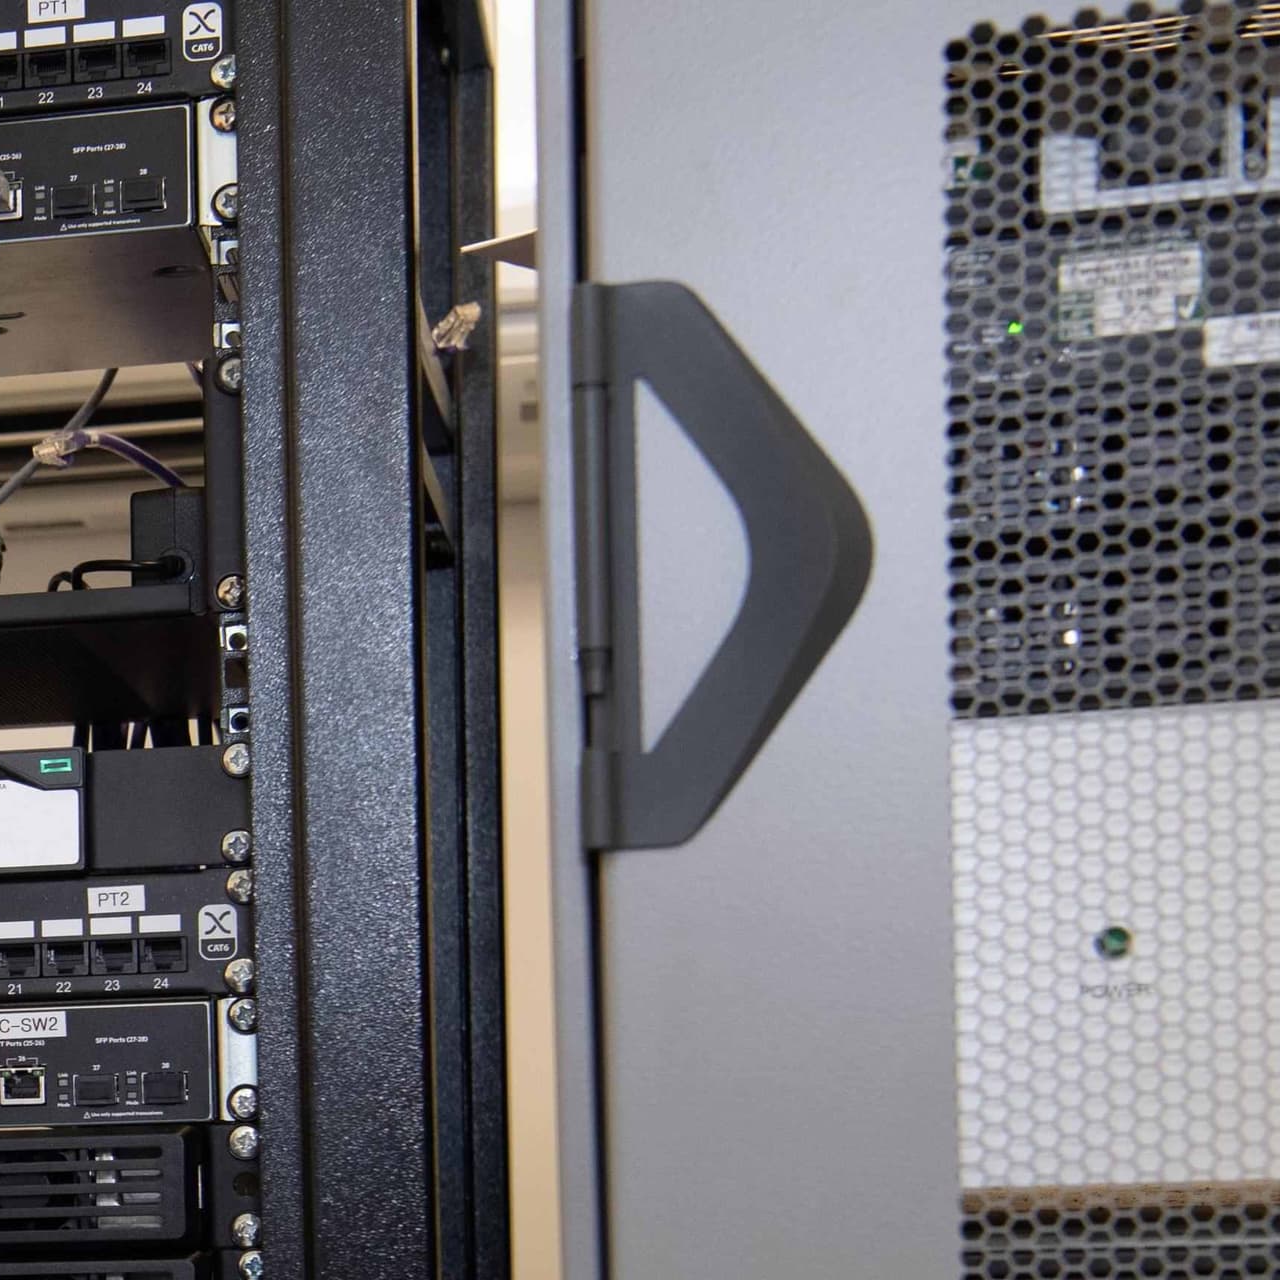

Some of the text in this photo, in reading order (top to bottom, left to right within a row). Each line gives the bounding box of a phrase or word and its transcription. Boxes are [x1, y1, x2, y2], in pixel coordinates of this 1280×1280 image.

[38, 0, 68, 16] PT1
[192, 44, 214, 53] CAT6
[87, 87, 103, 100] 23
[136, 82, 153, 94] 24
[38, 92, 55, 104] 22
[98, 891, 130, 907] PT2
[207, 943, 230, 953] CAT6
[7, 983, 22, 996] 21
[56, 981, 72, 993] 22
[104, 980, 120, 992] 23
[153, 978, 169, 990] 24
[1079, 982, 1153, 999] POWER
[5, 1040, 21, 1048] Ports
[108, 1036, 125, 1044] Ports
